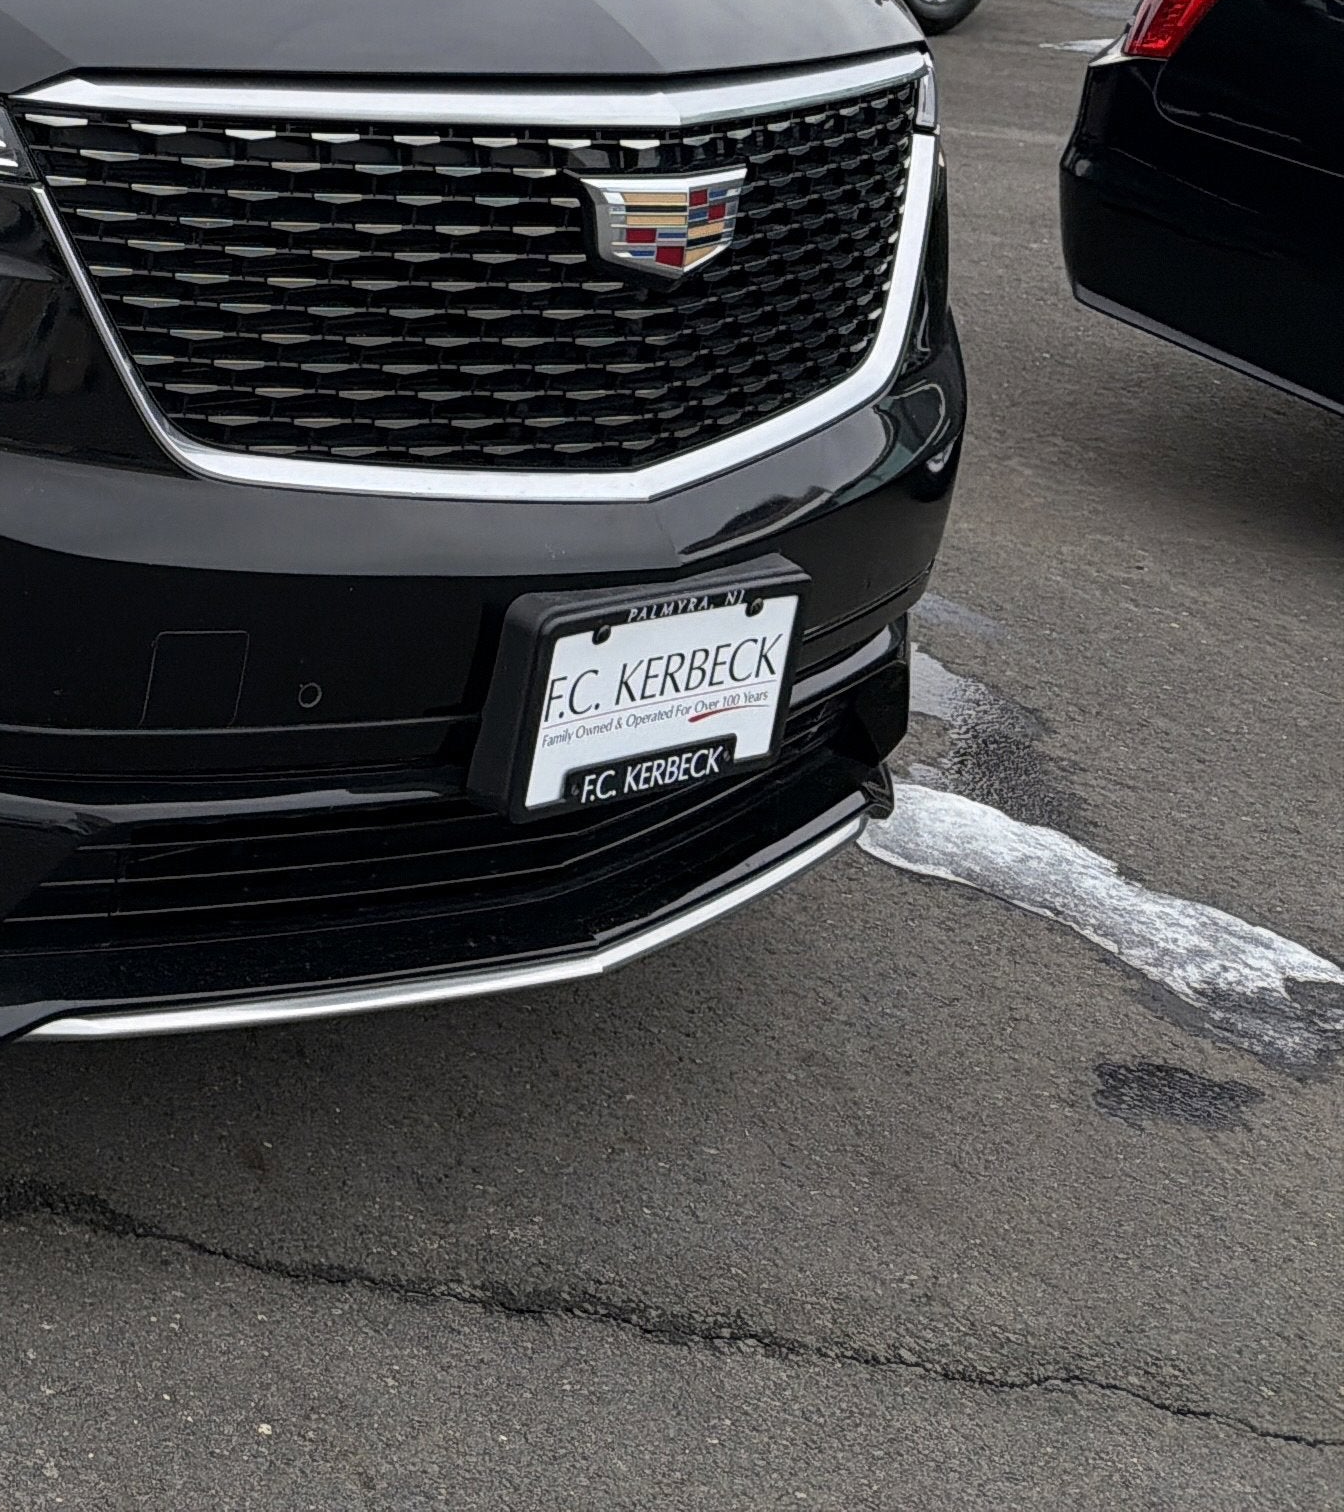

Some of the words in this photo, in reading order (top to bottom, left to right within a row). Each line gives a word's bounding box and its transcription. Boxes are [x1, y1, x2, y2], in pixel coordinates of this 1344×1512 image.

[725, 589, 746, 607] NJ
[544, 669, 601, 723] F.C.
[614, 633, 784, 707] KERBECK
[542, 727, 574, 749] Family
[575, 718, 613, 739] Owned
[614, 716, 623, 731] &
[625, 707, 674, 728] Operated
[675, 704, 693, 720] For
[694, 699, 720, 714] Over
[722, 694, 741, 708] 100
[743, 689, 769, 704] Years
[580, 769, 616, 804] F.C.
[623, 745, 724, 794] KERBECK
